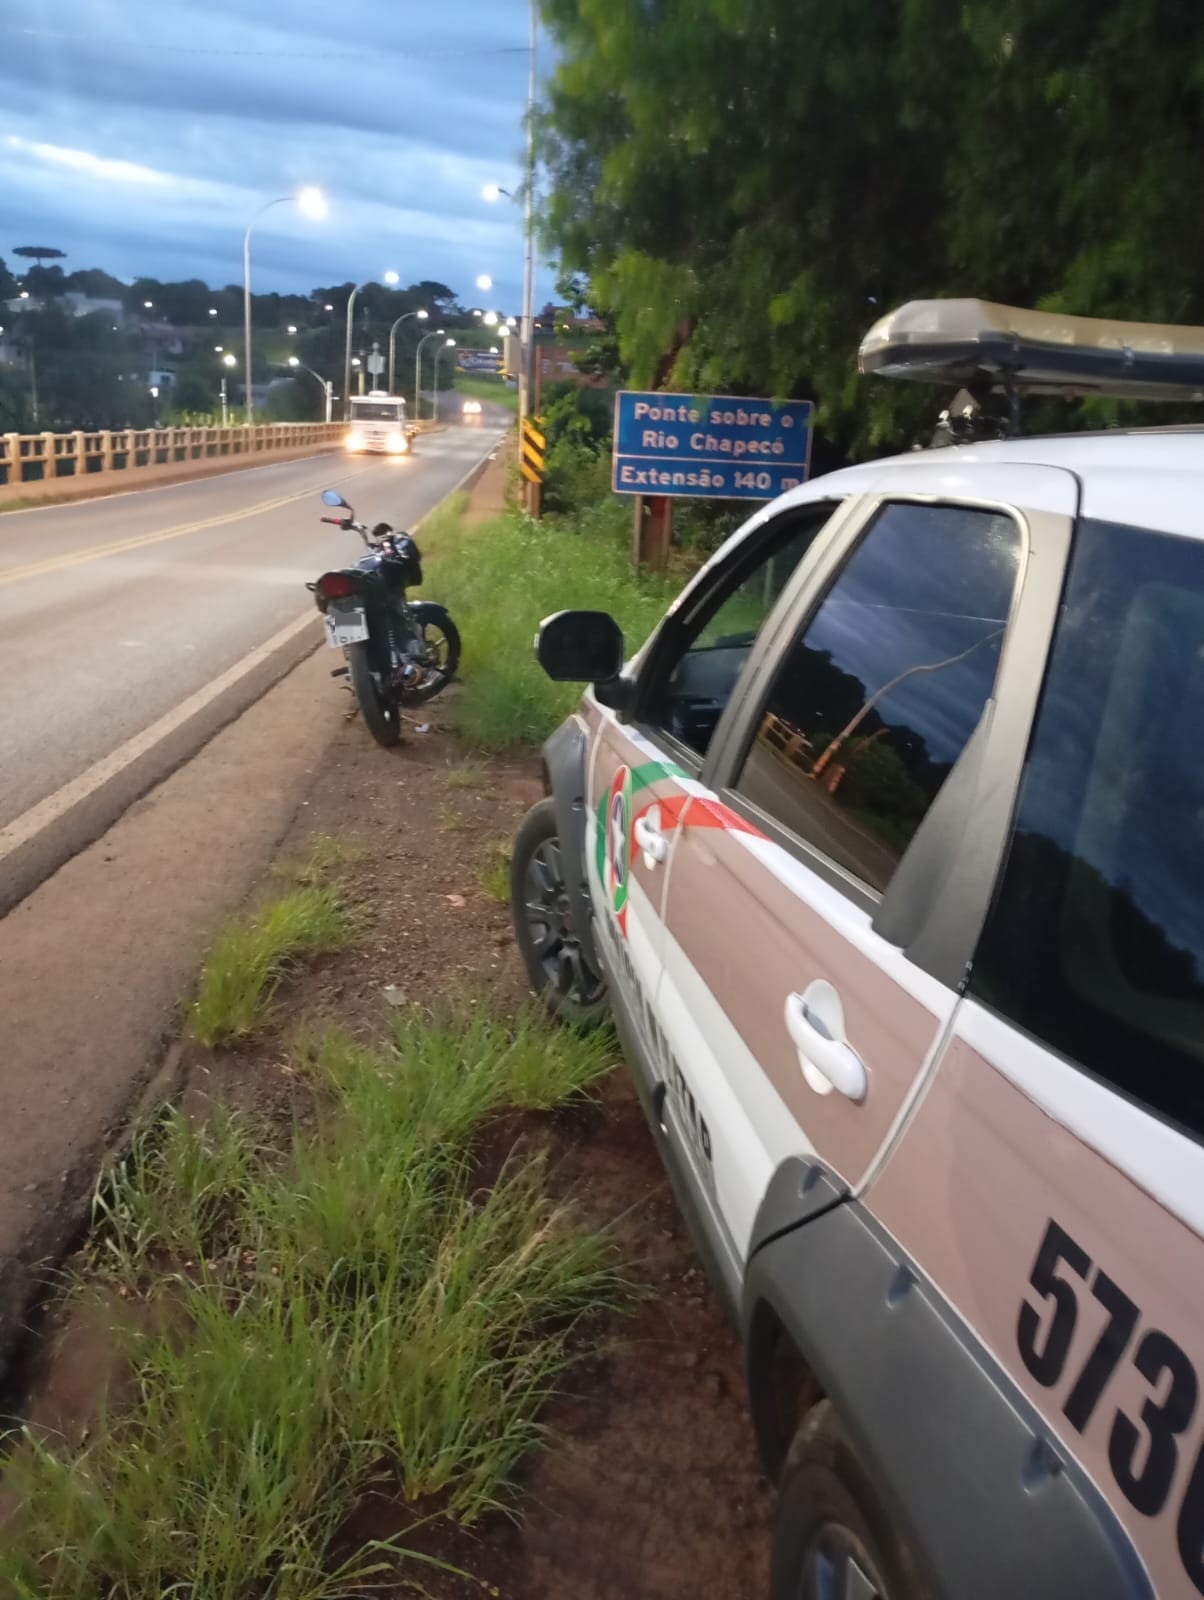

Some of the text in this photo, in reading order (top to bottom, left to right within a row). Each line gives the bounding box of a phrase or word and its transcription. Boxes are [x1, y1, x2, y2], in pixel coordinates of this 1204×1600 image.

[634, 402, 794, 428] Ponte sobre o
[642, 430, 785, 457] Rio Chapecó
[620, 465, 725, 488] Extensão
[734, 471, 771, 490] 140
